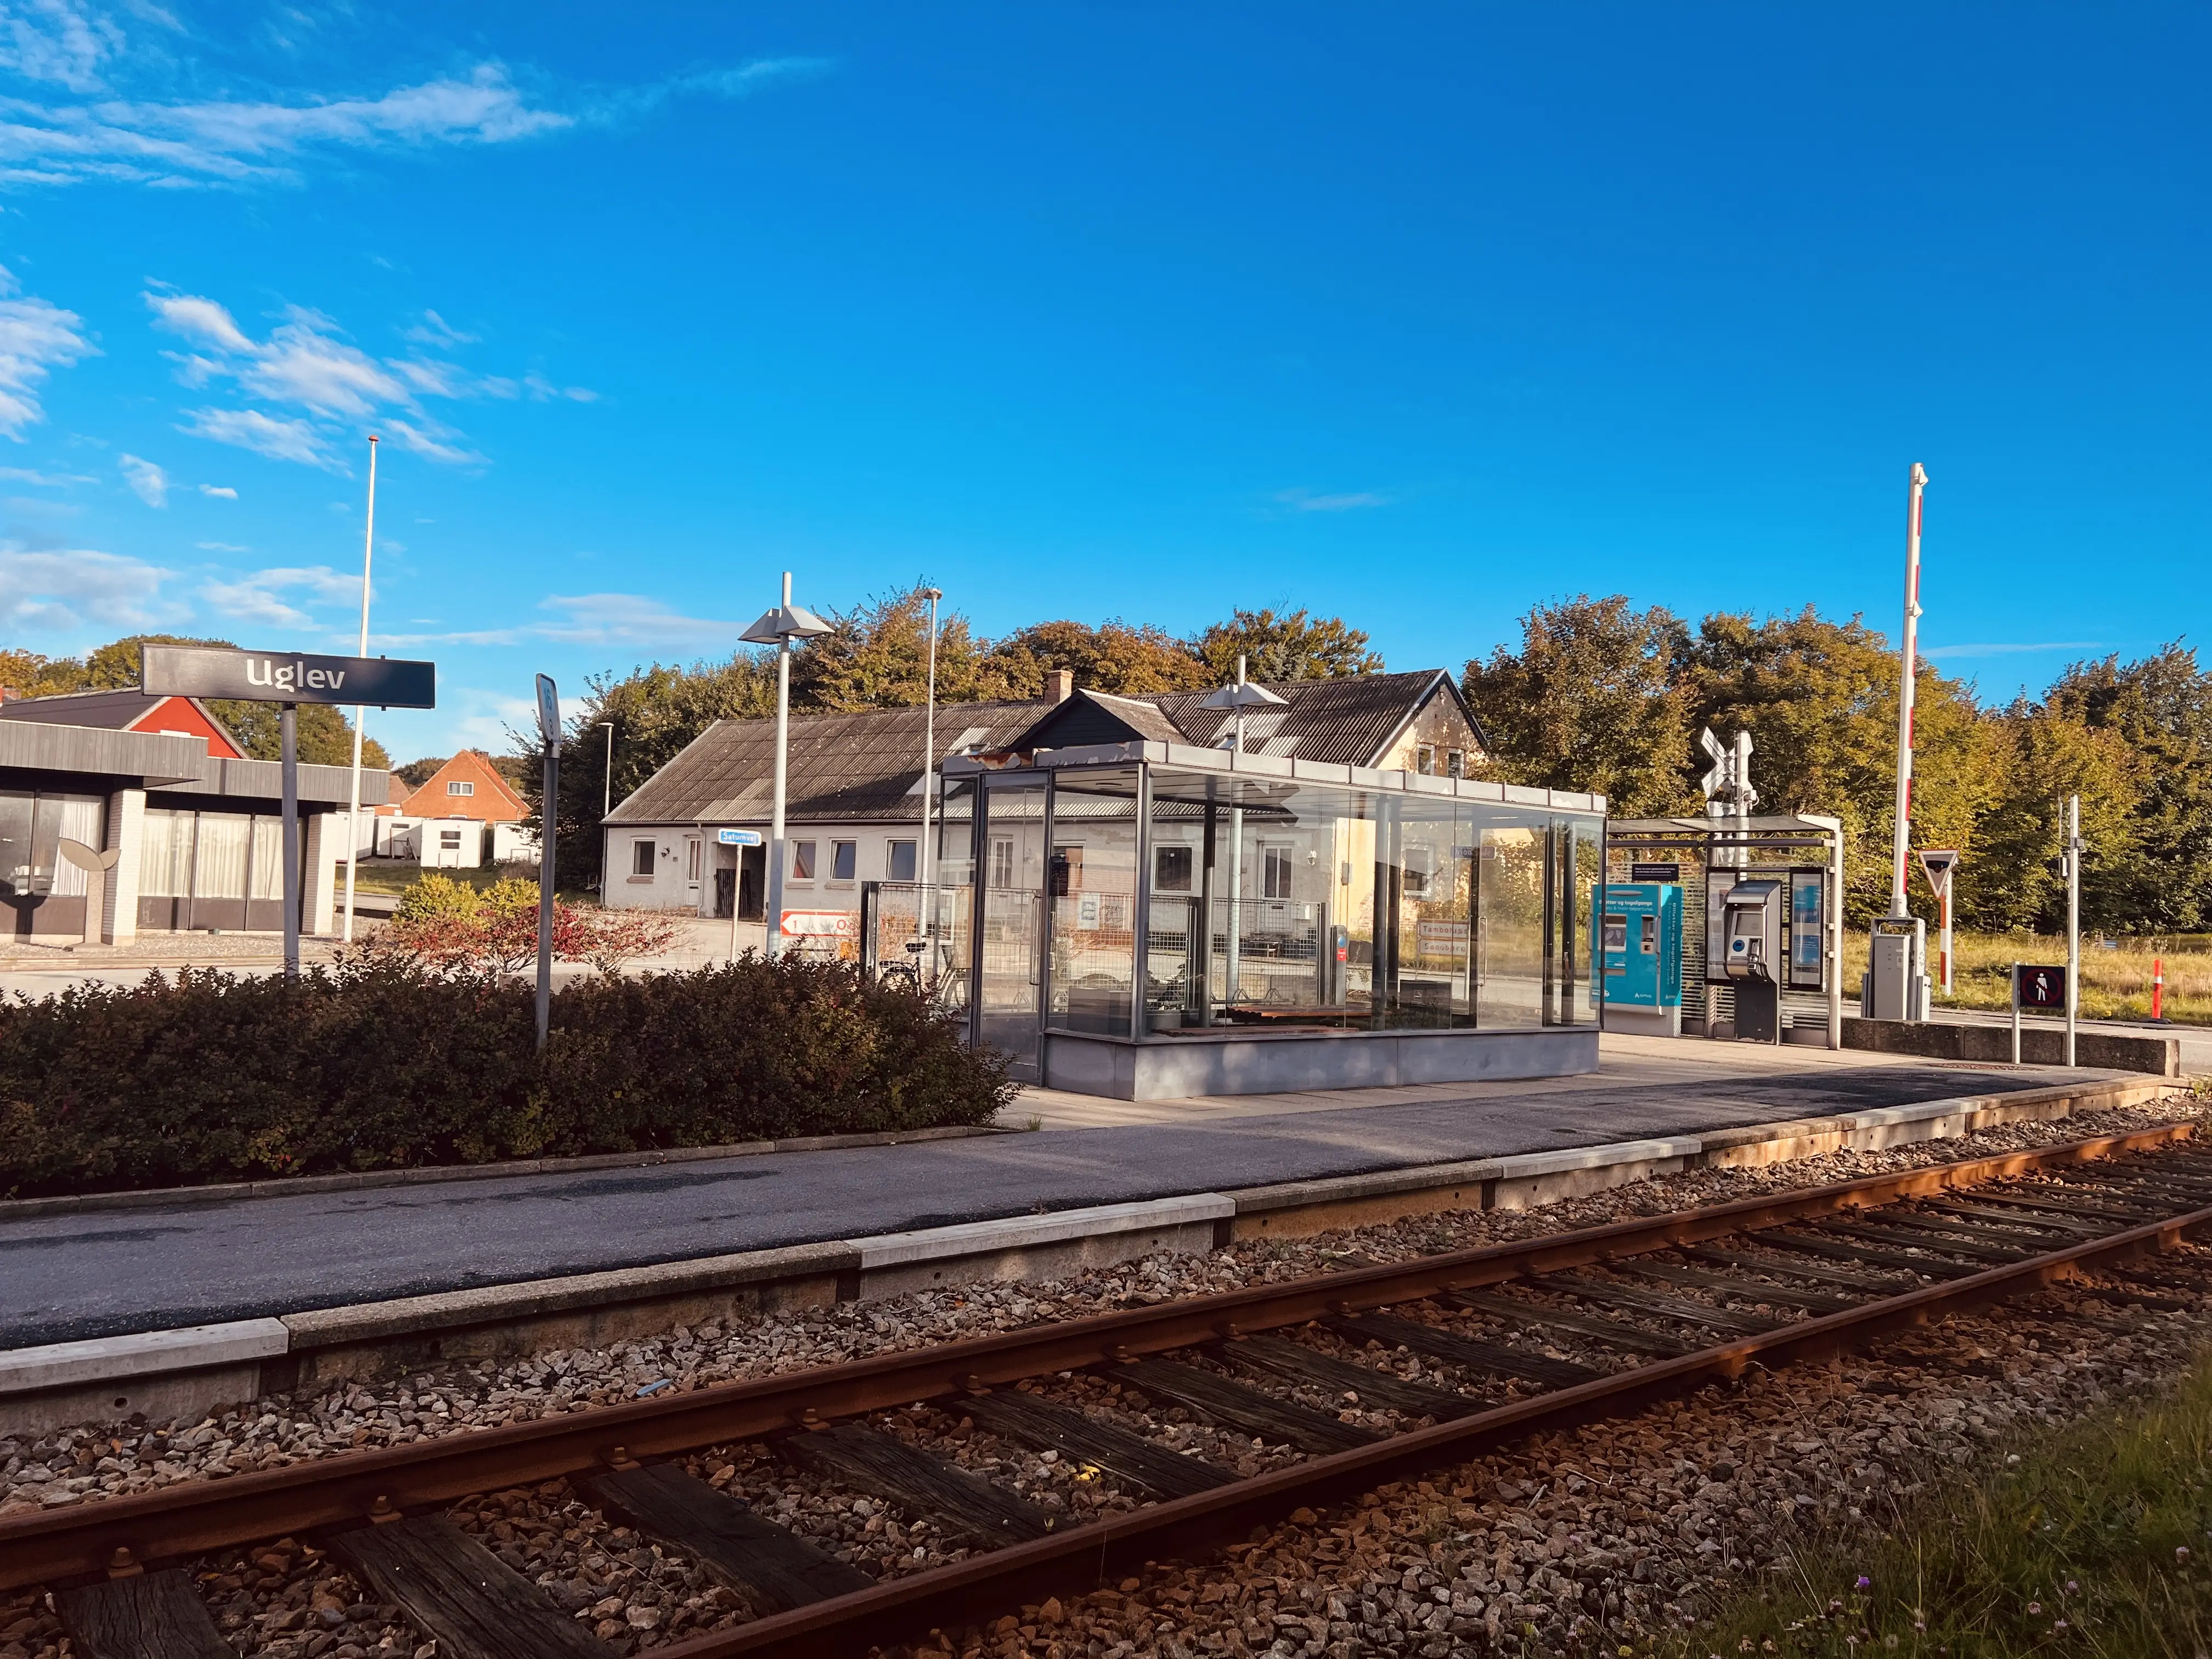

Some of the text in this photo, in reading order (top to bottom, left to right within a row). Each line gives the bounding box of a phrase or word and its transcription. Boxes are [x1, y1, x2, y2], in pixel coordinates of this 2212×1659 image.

[247, 659, 345, 693] Uglev
[544, 687, 552, 711] 16
[549, 718, 554, 735] 8
